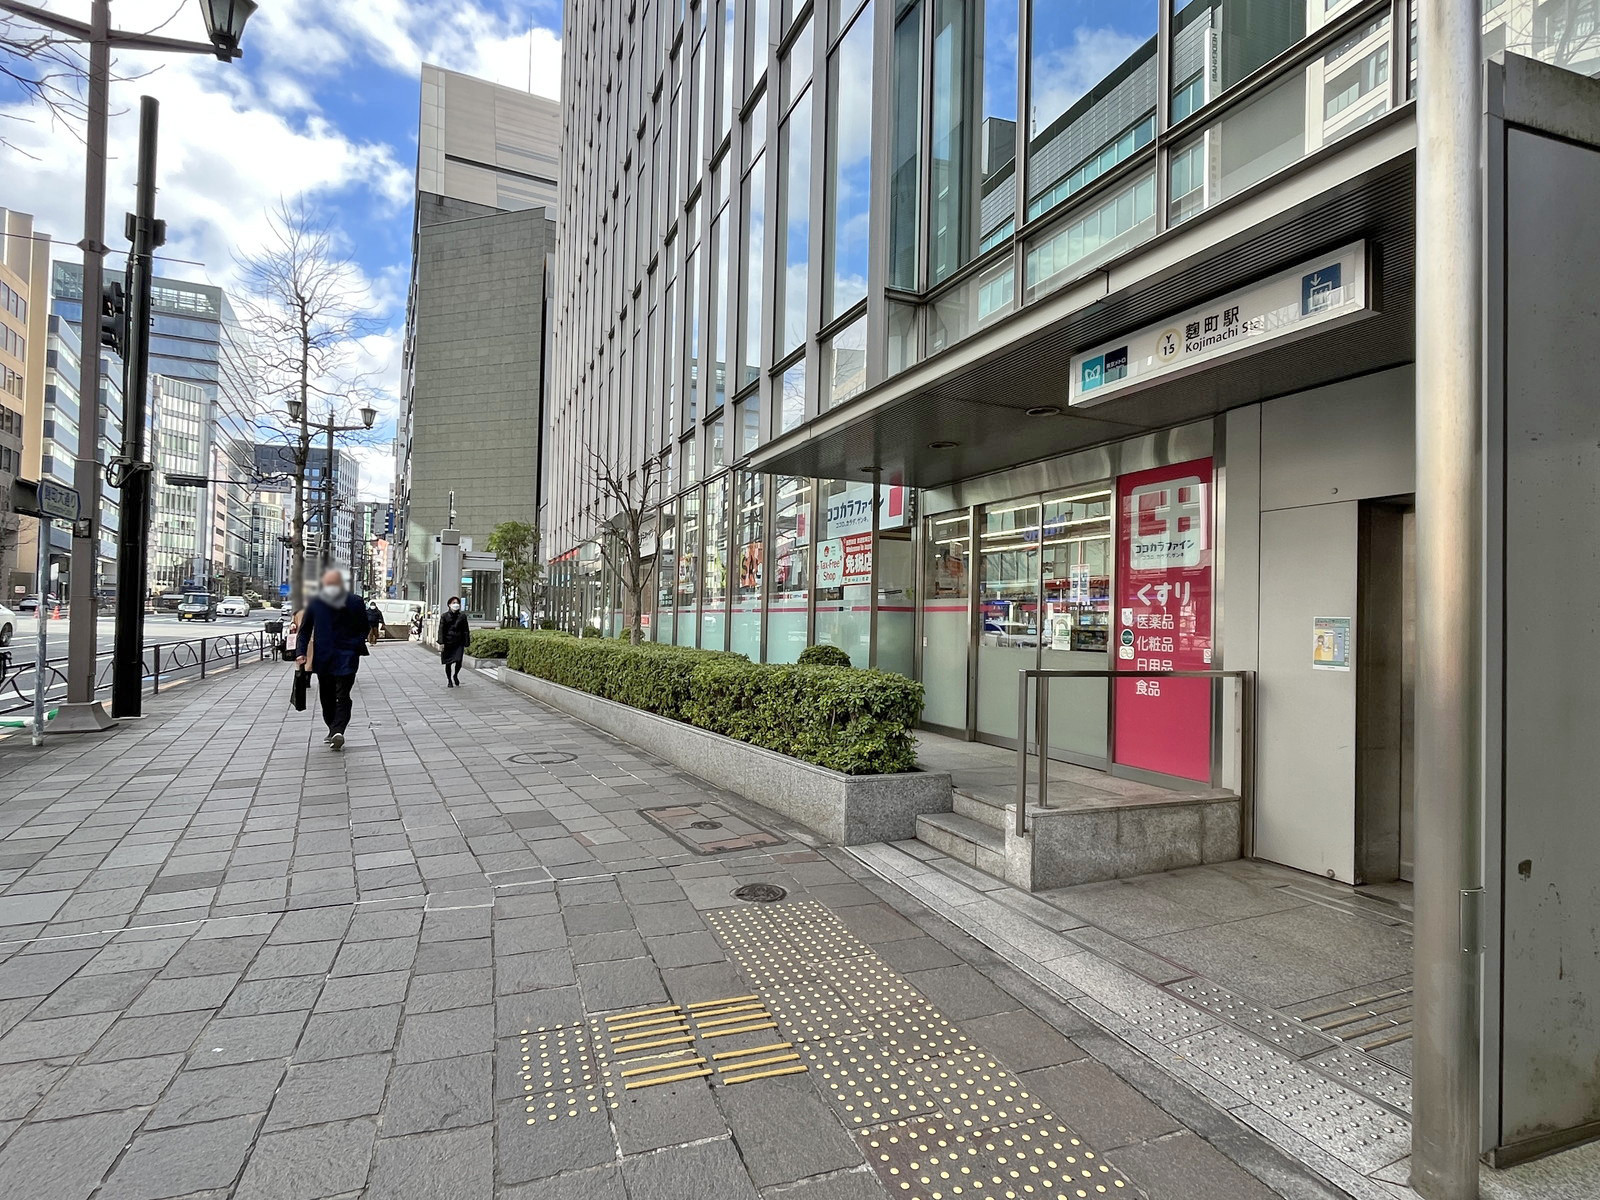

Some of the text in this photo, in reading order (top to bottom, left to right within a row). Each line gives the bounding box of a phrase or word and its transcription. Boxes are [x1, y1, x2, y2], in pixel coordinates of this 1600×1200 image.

[1166, 334, 1172, 344] Y
[1186, 325, 1238, 353] Kojimachi
[1163, 343, 1175, 355] 15
[1135, 540, 1194, 554] ココカラファイン
[820, 559, 840, 570] Tax-Free
[823, 571, 836, 581] Shop
[1137, 581, 1190, 606] くすり
[1137, 614, 1174, 630] 医薬品
[1137, 636, 1173, 652] 化粧品
[1137, 658, 1174, 671] 日用品
[1135, 679, 1160, 697] 食品
